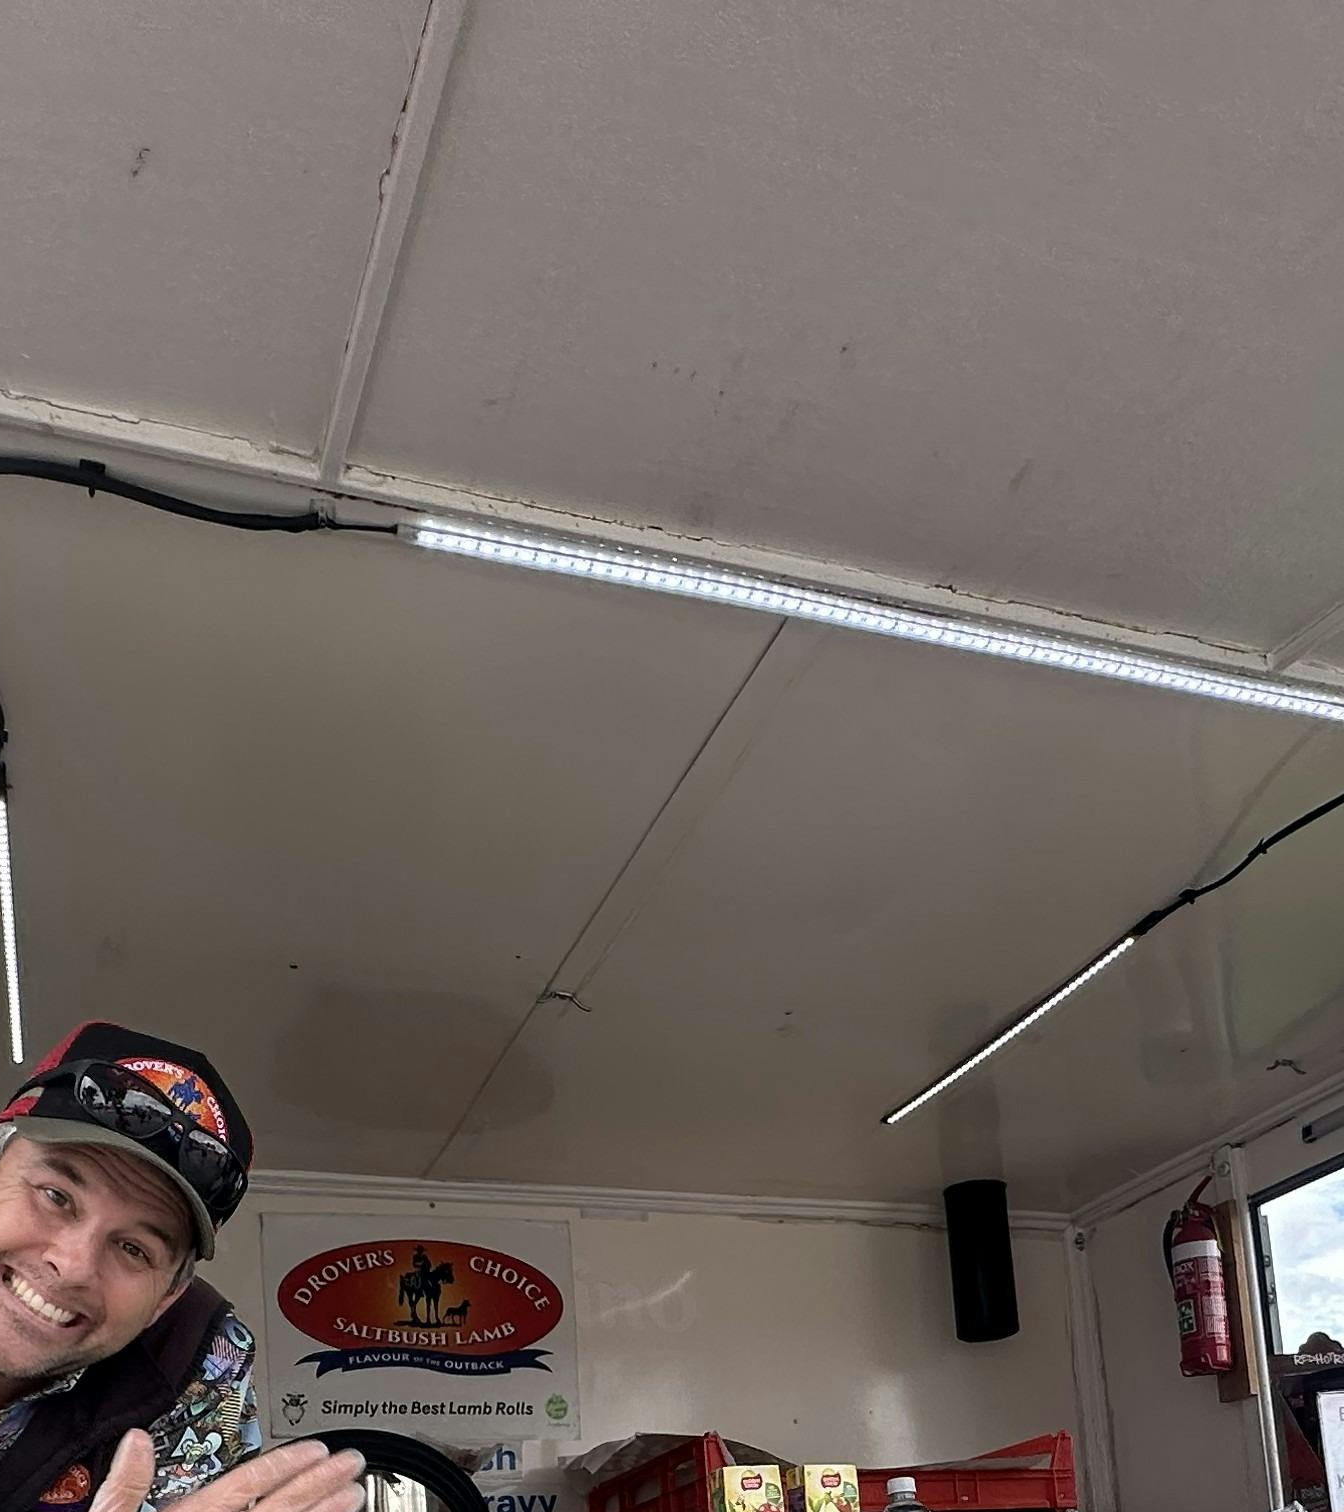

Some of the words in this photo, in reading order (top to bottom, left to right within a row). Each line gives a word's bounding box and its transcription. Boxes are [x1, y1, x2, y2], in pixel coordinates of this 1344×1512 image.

[294, 1249, 395, 1305] DROVER'S
[469, 1256, 551, 1311] CHOICE
[334, 1316, 447, 1346] SALTBUSH
[456, 1320, 516, 1345] LAMB
[348, 1352, 410, 1365] FLAVOUR
[444, 1359, 505, 1371] OUTBACK
[321, 1400, 379, 1417] Simply
[381, 1401, 407, 1416] the
[410, 1401, 446, 1416] Best
[449, 1401, 493, 1416] Lamb
[495, 1401, 534, 1416] Rolls
